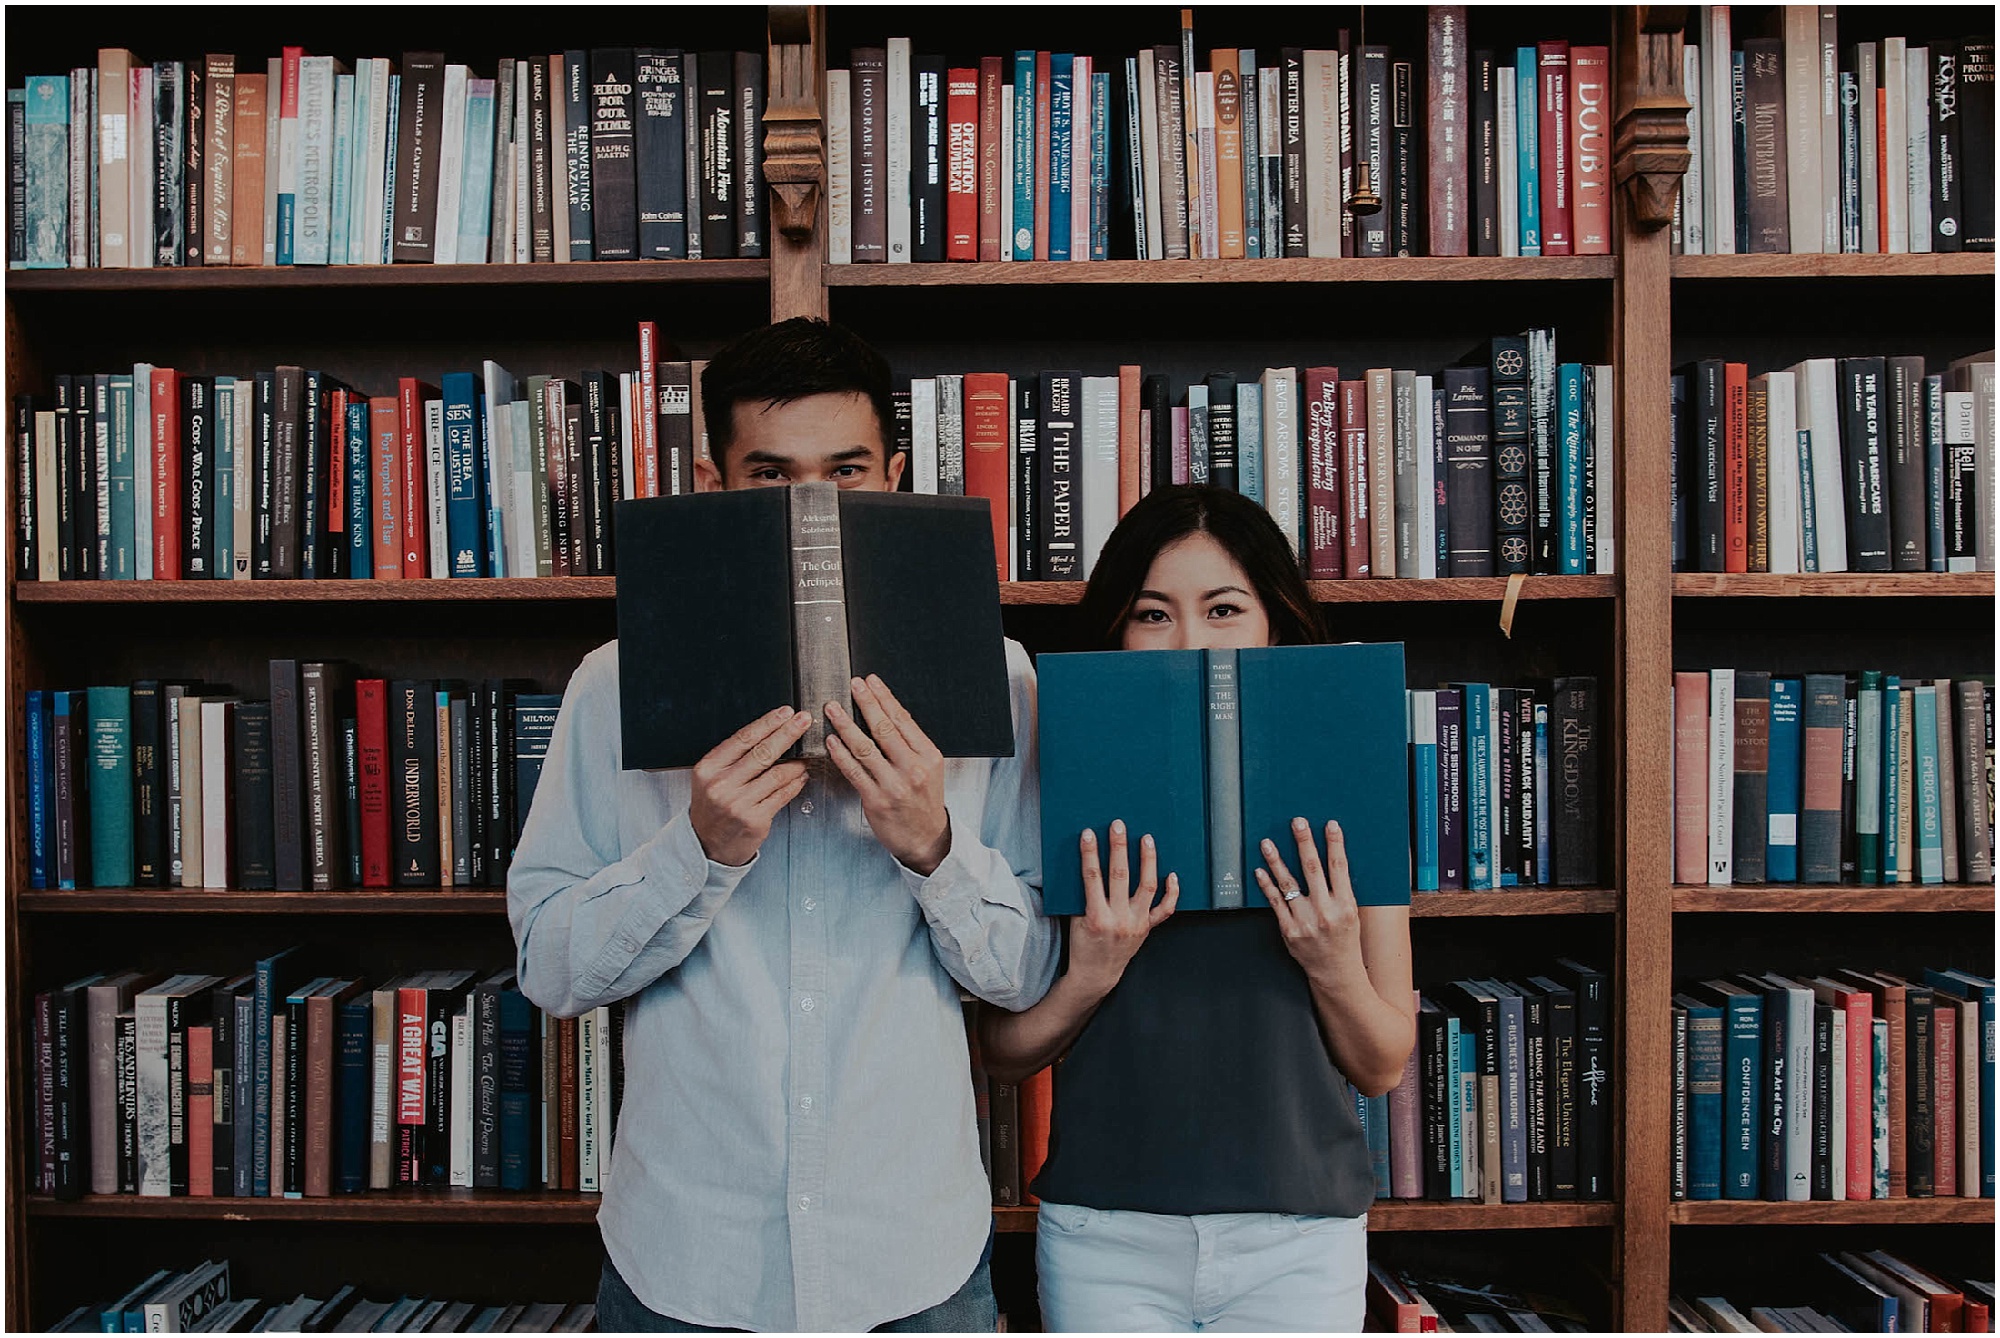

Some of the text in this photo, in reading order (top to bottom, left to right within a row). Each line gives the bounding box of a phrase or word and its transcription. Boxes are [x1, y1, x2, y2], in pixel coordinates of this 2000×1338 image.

[533, 65, 542, 101] DEARLING
[593, 84, 632, 95] HERO
[605, 73, 616, 83] A
[640, 66, 677, 75] FRINGES
[1734, 64, 1744, 124] THE LEGACY
[1938, 54, 1956, 122] FONDA
[1963, 64, 1994, 73] PROUD
[593, 120, 631, 131] TIME
[597, 108, 626, 118] OUR
[598, 96, 624, 106] FOR
[1288, 58, 1299, 144] A BETTER IDEA
[1370, 83, 1380, 125] LUDWIG
[303, 72, 321, 238] NATURE'S METROPOLIS
[567, 130, 578, 205] THE BAZAAR
[578, 125, 591, 211] REINVENTING
[717, 108, 730, 201] Mountain Fires
[861, 79, 873, 215] HONORABLE JUSTICE
[950, 123, 962, 193] DRUMBEAT
[962, 122, 974, 194] OPERATION
[1170, 60, 1186, 228] ALL THE PRESIDENT'S MEN
[1755, 103, 1777, 198] MOUNTBATTEN
[536, 163, 544, 213] SYMPHONIES
[986, 142, 996, 214] No Comebacks
[446, 410, 472, 420] SEN
[642, 328, 654, 448] Ceramics in the Pacific Northwest
[1052, 378, 1060, 412] KLUGER
[1061, 378, 1069, 416] RICHARD
[350, 437, 362, 465] LORDS
[452, 429, 461, 492] OF JUSTICE
[462, 429, 471, 480] THE IDEA
[567, 418, 580, 462] Longitude
[1020, 419, 1036, 453] BRAZIL
[1276, 378, 1288, 480] SEVEN ARROWS
[1308, 401, 1323, 489] Correspondence
[1320, 381, 1336, 491] The Berg-Schoenberg
[1708, 417, 1717, 502] The American West
[1865, 374, 1881, 514] THE YEAR OF THE BARRICADES
[1960, 401, 1974, 472] Daniel Bell
[96, 422, 110, 536] EINSTEIN'S UNIVERSE
[157, 414, 166, 517] Danes in North America
[353, 470, 361, 481] OF
[380, 433, 394, 546] For Prophet and Tsar
[1053, 432, 1070, 538] THE PAPER
[353, 485, 362, 518] HUMAN
[556, 456, 568, 568] PRODUCING INDIA
[354, 523, 362, 547] KIND
[800, 560, 840, 571] The Gul
[1210, 702, 1236, 710] RIGHT
[1215, 692, 1232, 700] THE
[1521, 698, 1531, 723] WEIR
[345, 728, 355, 782] Tchaikovsky
[1563, 717, 1578, 815] KINGDOM
[1578, 726, 1591, 751] The
[1970, 738, 1978, 759] PLOT
[308, 687, 324, 867] SEVENTEENTH CENTURY NORTH AMERICA
[404, 758, 421, 843] UNDERWORLD
[1521, 730, 1532, 849] SINGLEJACK SOLIDARITY
[1922, 756, 1935, 803] AMERICA
[1925, 806, 1935, 831] AND
[58, 1008, 67, 1032] TELL
[59, 1035, 67, 1050] ME
[60, 1058, 68, 1088] STORY
[401, 1014, 422, 1119] A GREAT WALL
[1535, 1037, 1545, 1154] READING THE WASTE LAND
[1561, 1036, 1572, 1148] The Elegant Universe
[1582, 1055, 1606, 1106] caffeine
[1772, 1058, 1784, 1136] The Art of the City
[42, 1042, 54, 1155] REQUIRED READING
[480, 1053, 495, 1155] The Collected Poems
[1741, 1057, 1751, 1150] CONFIDENCE MEN
[152, 1313, 162, 1332] Cre
